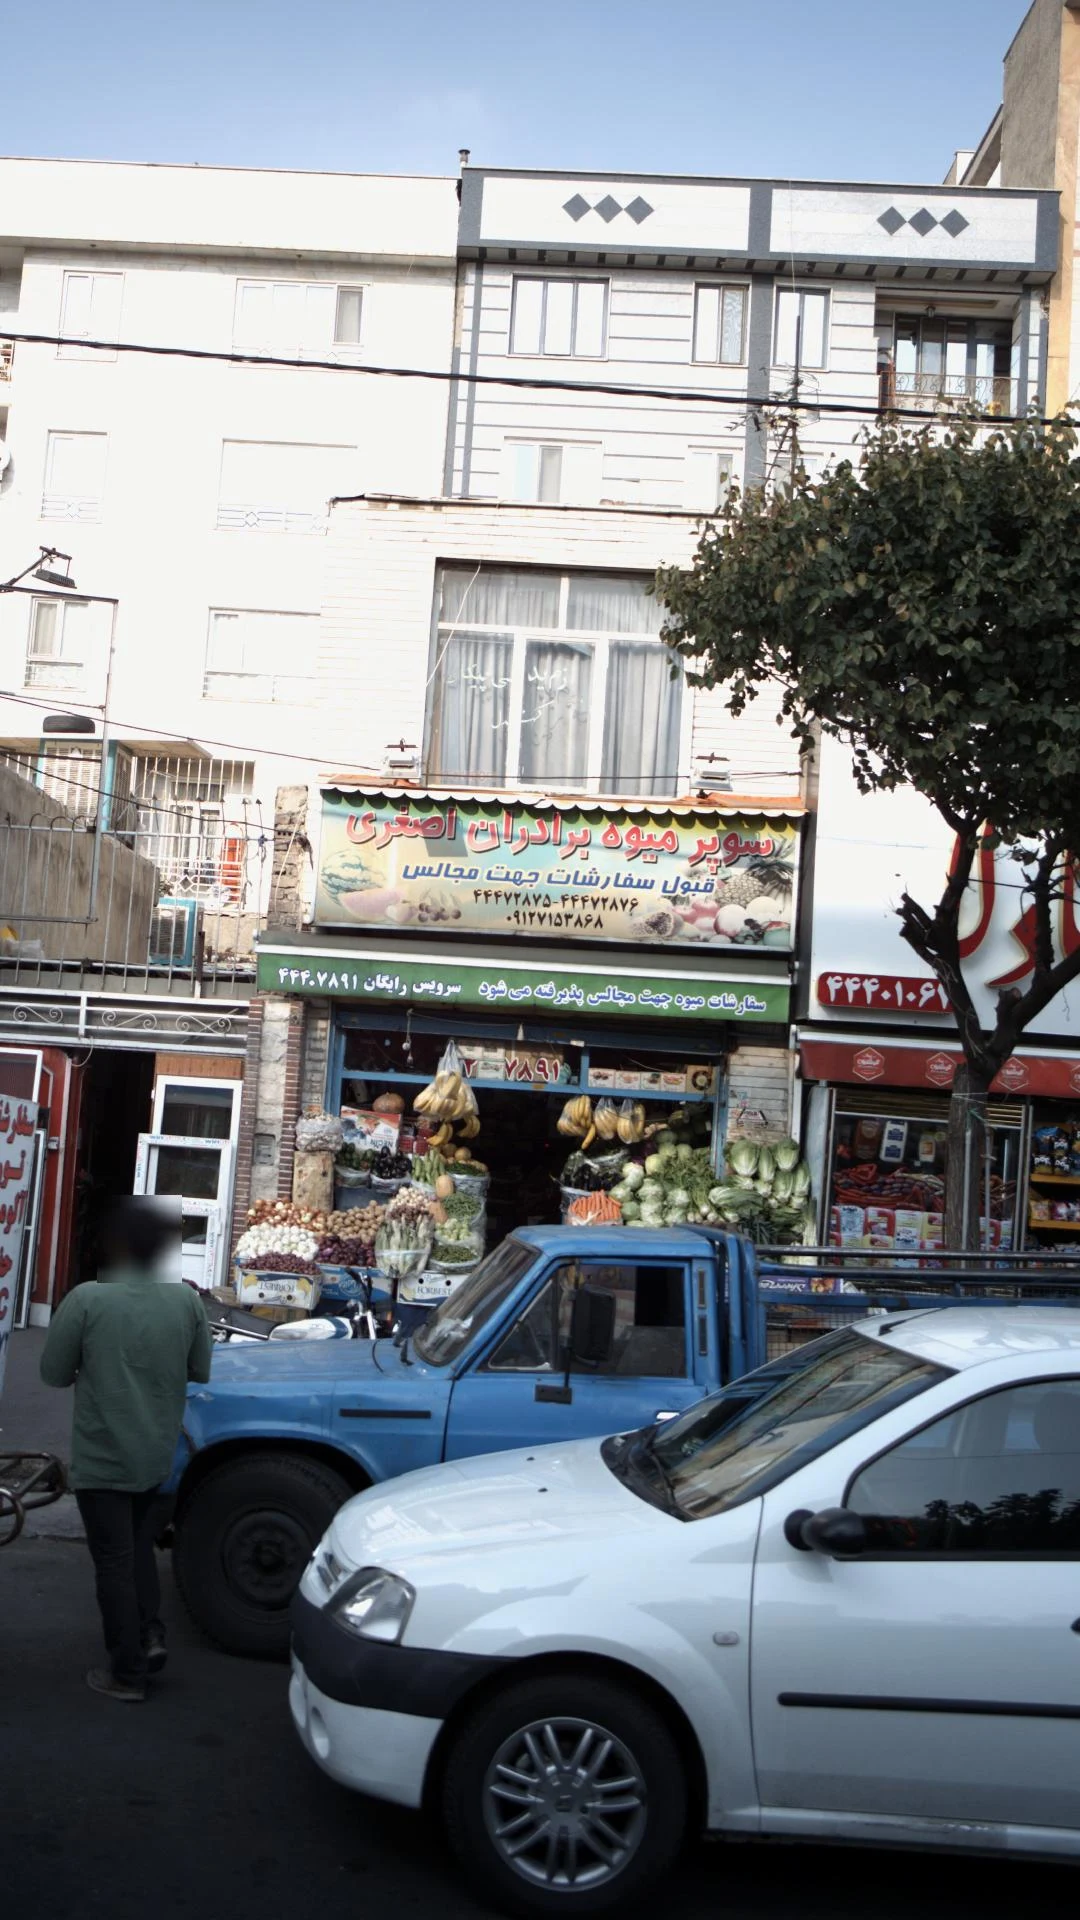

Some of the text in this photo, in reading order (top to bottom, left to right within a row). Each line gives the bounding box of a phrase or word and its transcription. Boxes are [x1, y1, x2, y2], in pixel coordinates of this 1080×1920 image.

[346, 804, 775, 873] سوپر میوه برادران اصغری
[402, 862, 716, 896] قبول سفارشات جهت مجالس
[278, 967, 461, 997] سرویس رایگان ۴۴۴۰۷۸۹۱
[479, 980, 767, 1015] سفارشات میوه جهت مجالس پذیرفته می شود
